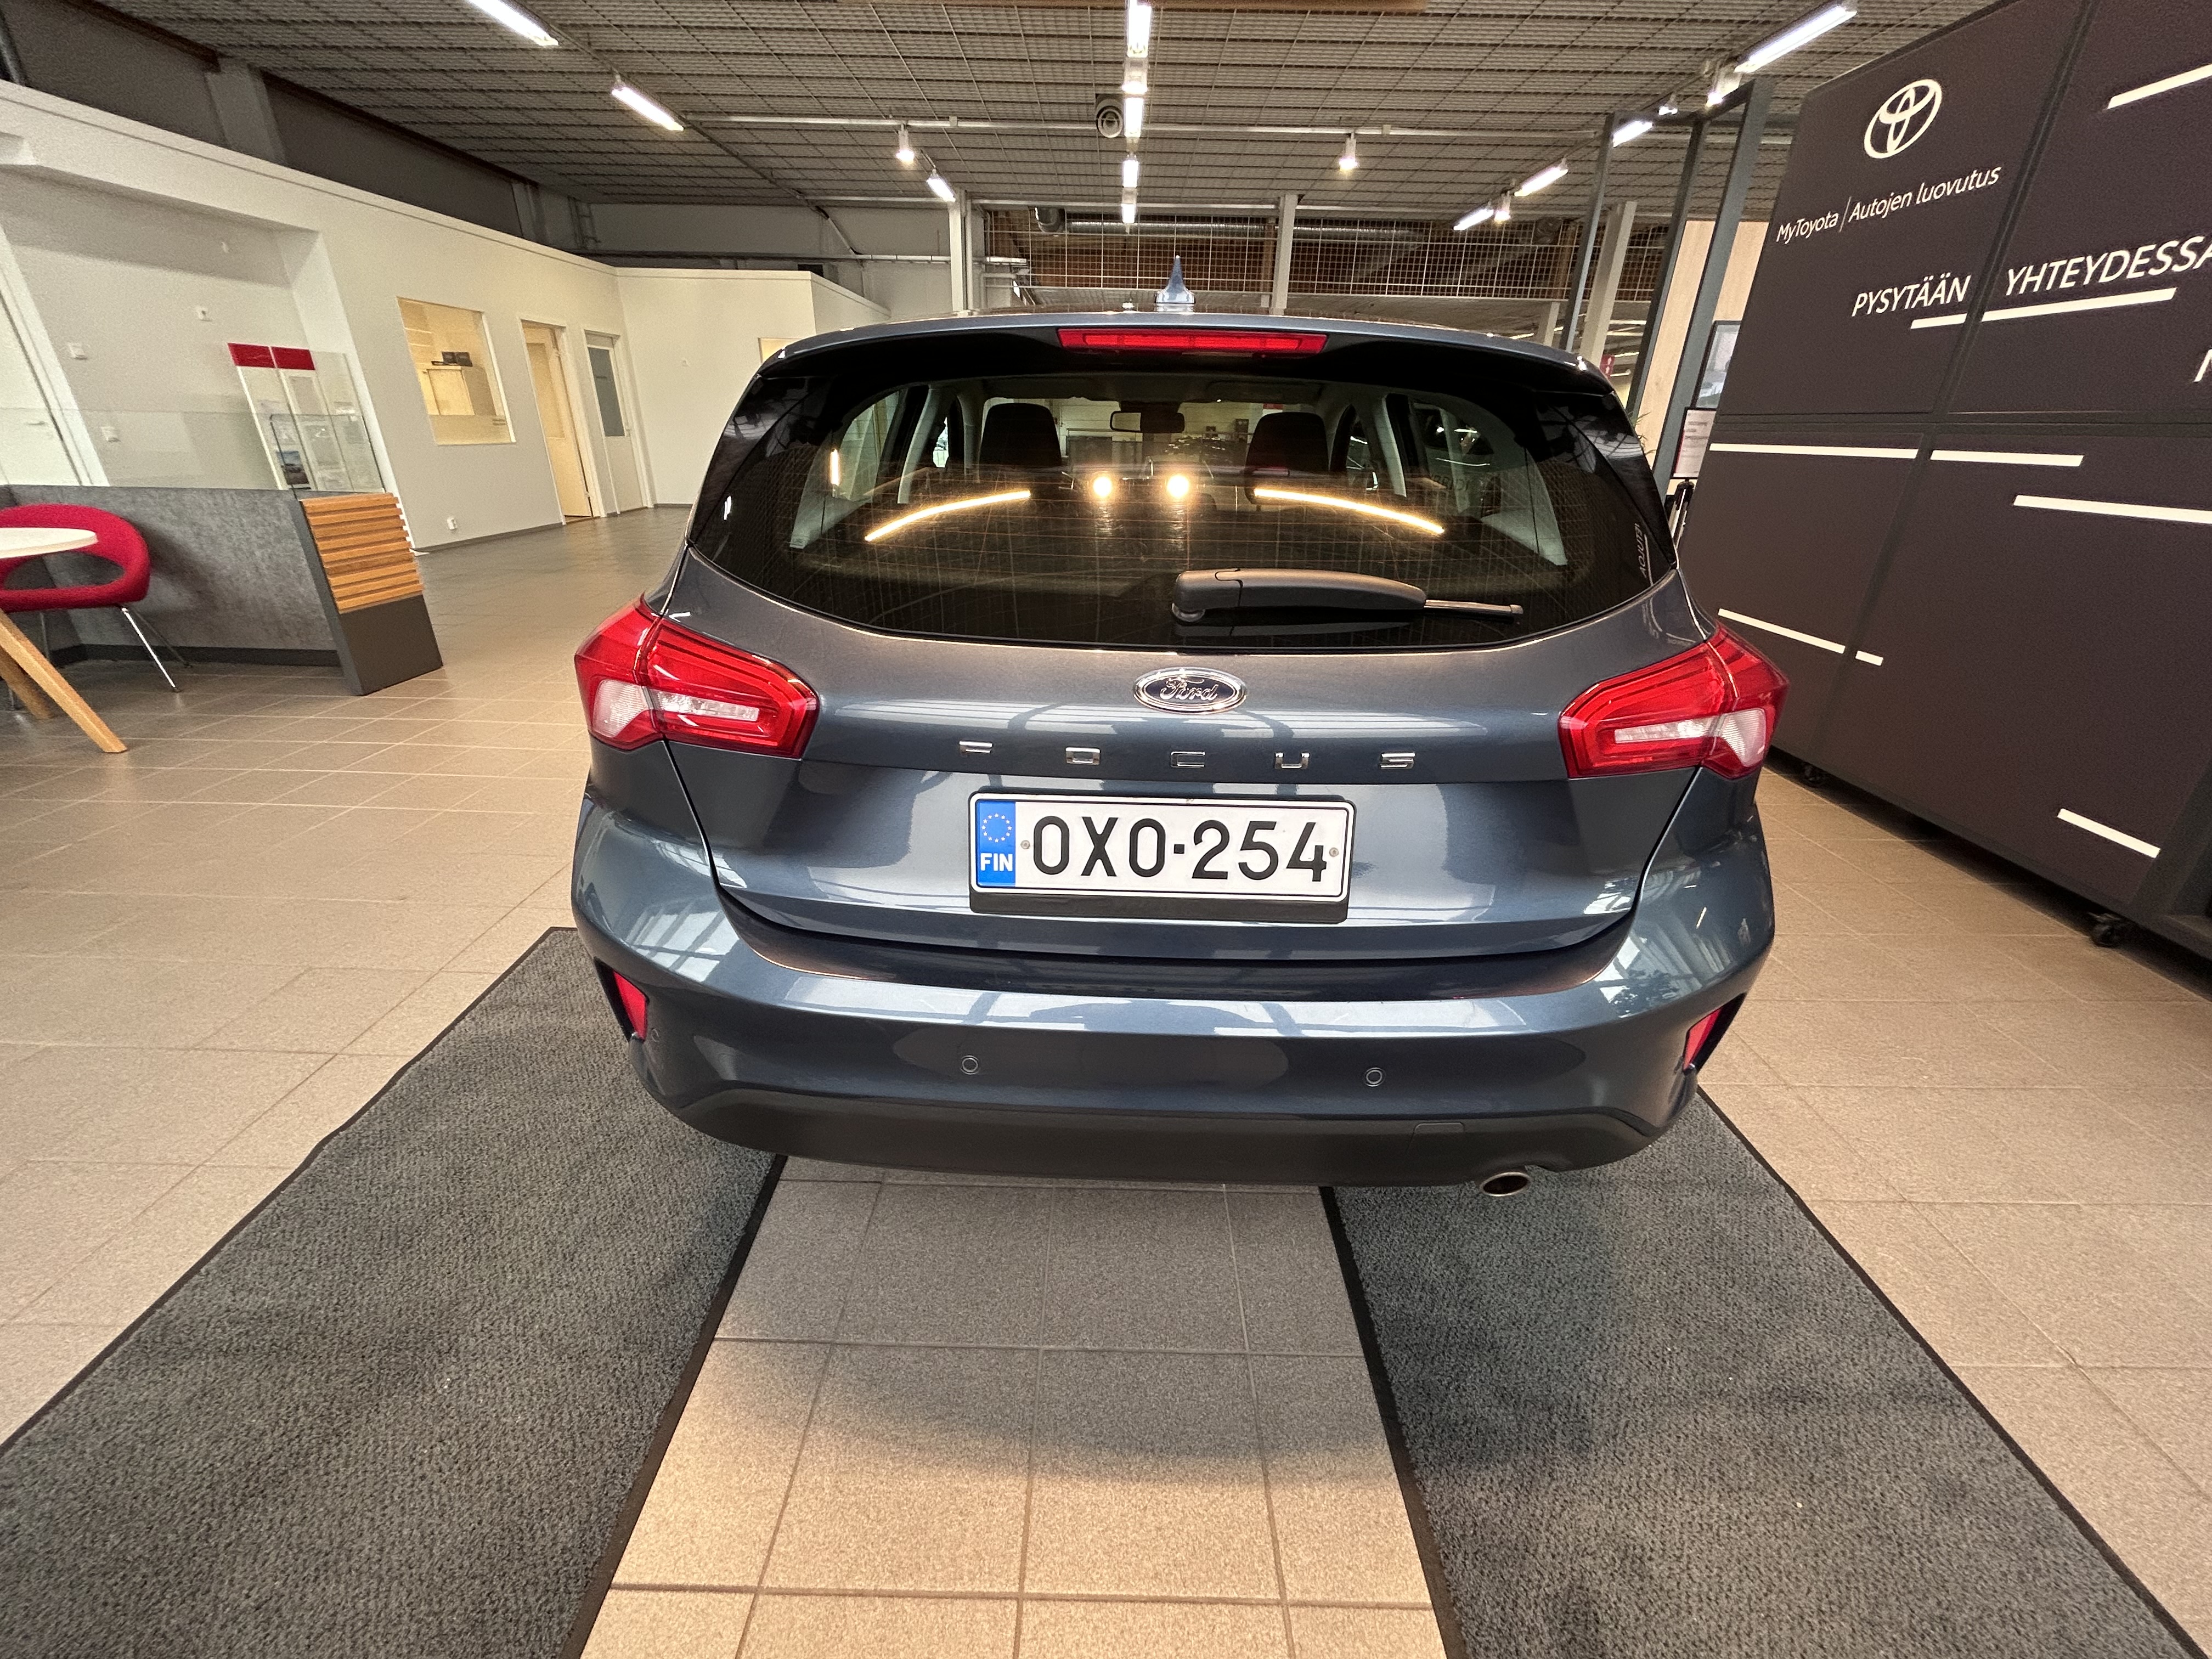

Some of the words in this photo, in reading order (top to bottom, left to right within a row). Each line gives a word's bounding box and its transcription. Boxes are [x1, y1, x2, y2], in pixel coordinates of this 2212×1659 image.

[1776, 211, 1839, 244] MyToyota
[1848, 190, 1913, 222] Autojen
[1916, 166, 2002, 205] luovutus
[1852, 273, 1972, 317] PYSYTÄÄN
[1159, 676, 1219, 701] Ford
[958, 741, 1416, 769] FOCUS
[980, 853, 1013, 872] FIN
[1032, 815, 1327, 882] OXO-254
